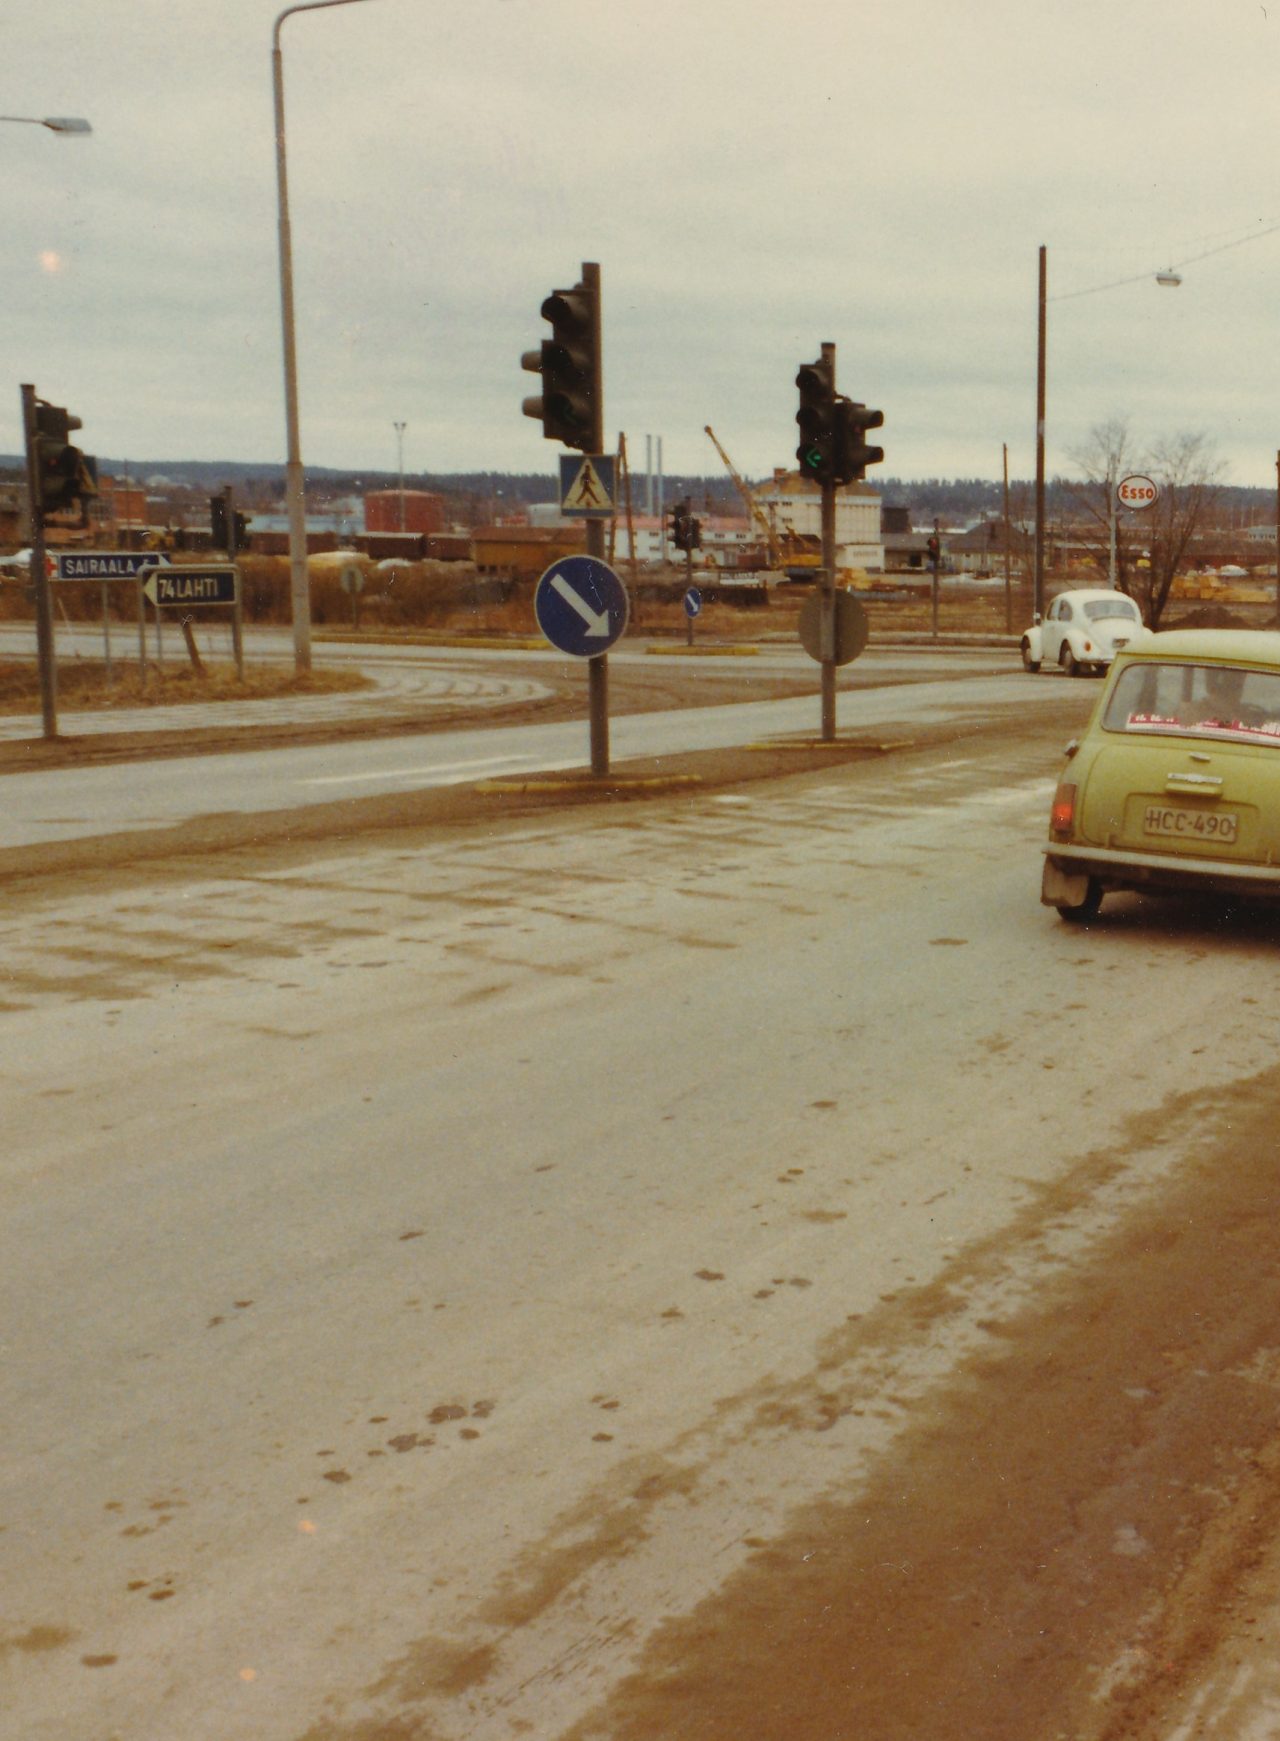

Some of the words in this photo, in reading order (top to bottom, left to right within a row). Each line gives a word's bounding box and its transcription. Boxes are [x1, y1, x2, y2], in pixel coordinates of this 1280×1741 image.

[65, 559, 136, 575] SAIRAALA
[176, 577, 219, 598] LAHTI
[1148, 809, 1233, 836] HCC-490
